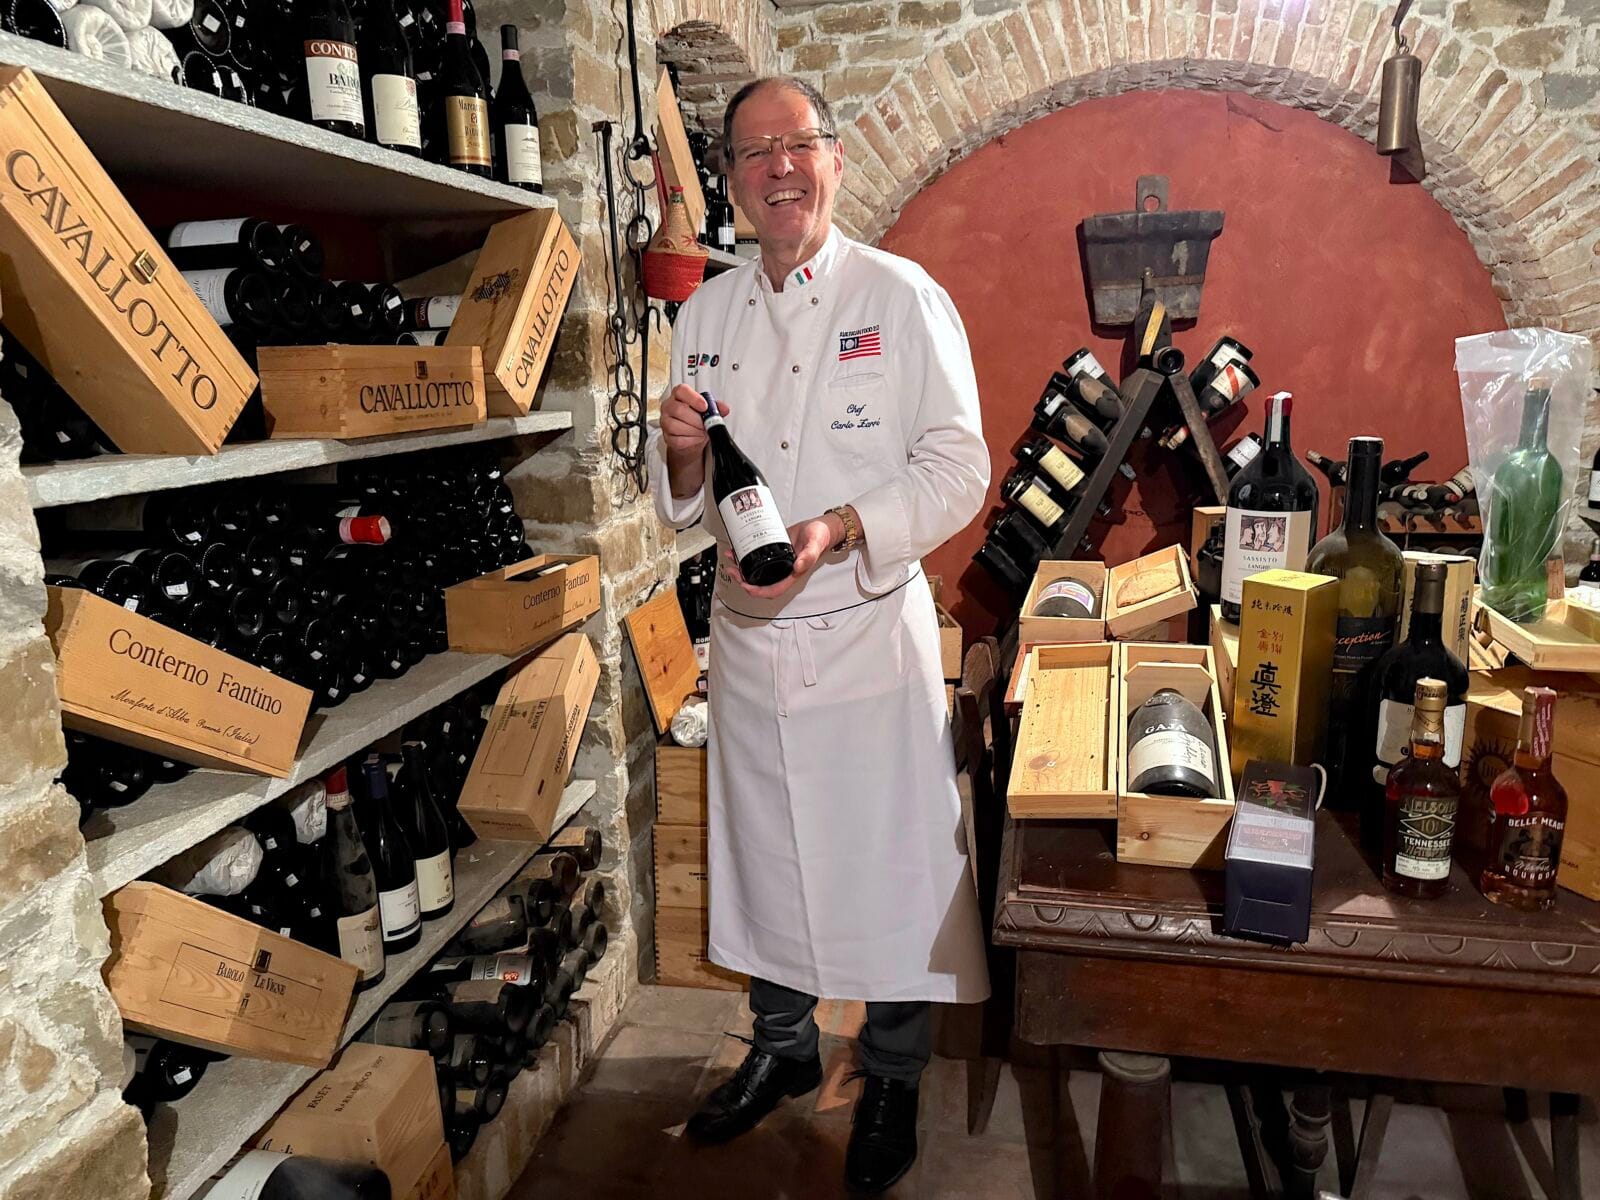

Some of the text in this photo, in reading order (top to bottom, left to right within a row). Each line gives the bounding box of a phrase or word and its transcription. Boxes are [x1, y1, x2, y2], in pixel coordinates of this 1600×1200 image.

[5, 149, 218, 410] CAVALLOTTO
[514, 248, 569, 389] CAVALLOTTO
[359, 380, 475, 413] CAVALLOTTO
[846, 403, 867, 416] Chef
[830, 420, 855, 430] Carlo
[1242, 554, 1278, 563] SASSISTO
[522, 572, 590, 610] Conterno Fantino
[109, 628, 282, 715] Conterno Fantino
[110, 688, 156, 711] Monforte
[156, 705, 191, 724] d'Alba
[222, 725, 260, 745] (Italia)
[1145, 723, 1188, 734] GAJA
[1508, 816, 1564, 830] BELLE MEADE
[1403, 835, 1452, 848] TENNESSEE
[1504, 864, 1556, 881] BOURBON
[216, 961, 287, 996] BAROLO LE VIGNE
[307, 1084, 333, 1109] FASET
